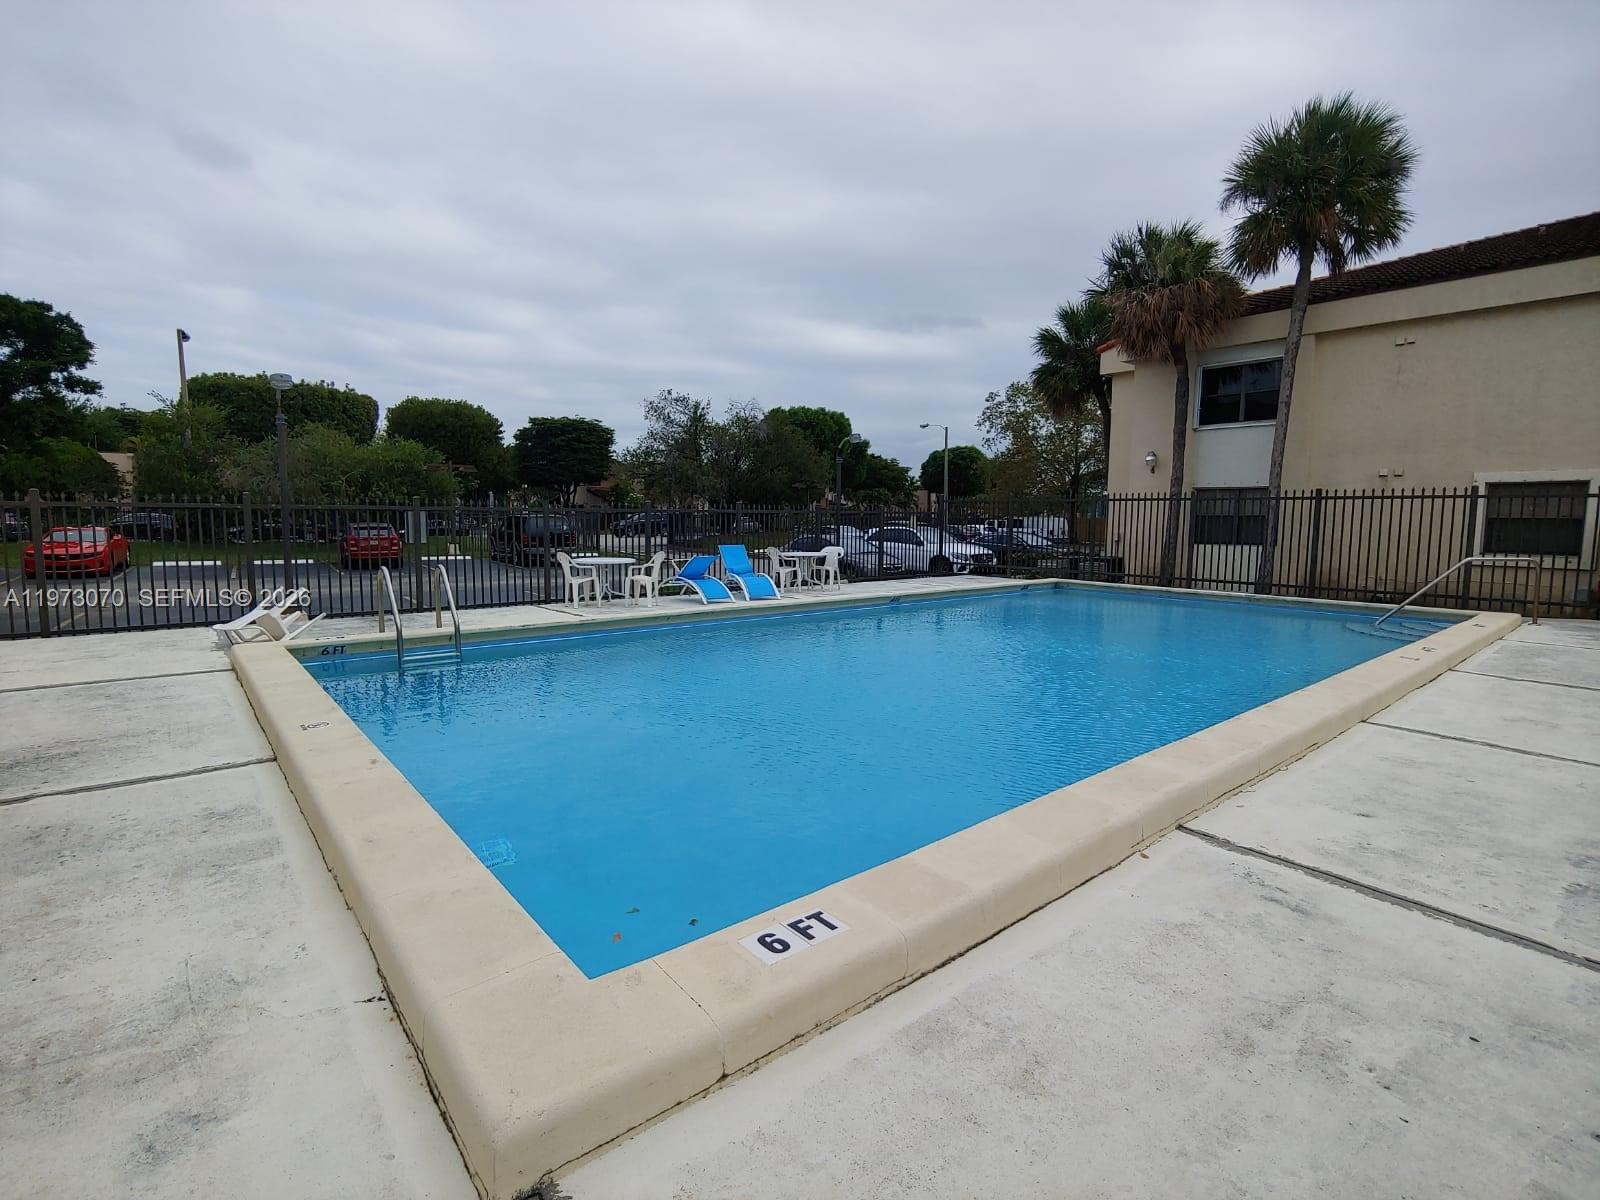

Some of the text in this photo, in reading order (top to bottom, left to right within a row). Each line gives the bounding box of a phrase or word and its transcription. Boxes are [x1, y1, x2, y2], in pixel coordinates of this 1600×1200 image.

[321, 645, 347, 656] 6 FT
[757, 911, 838, 953] 6 FT
